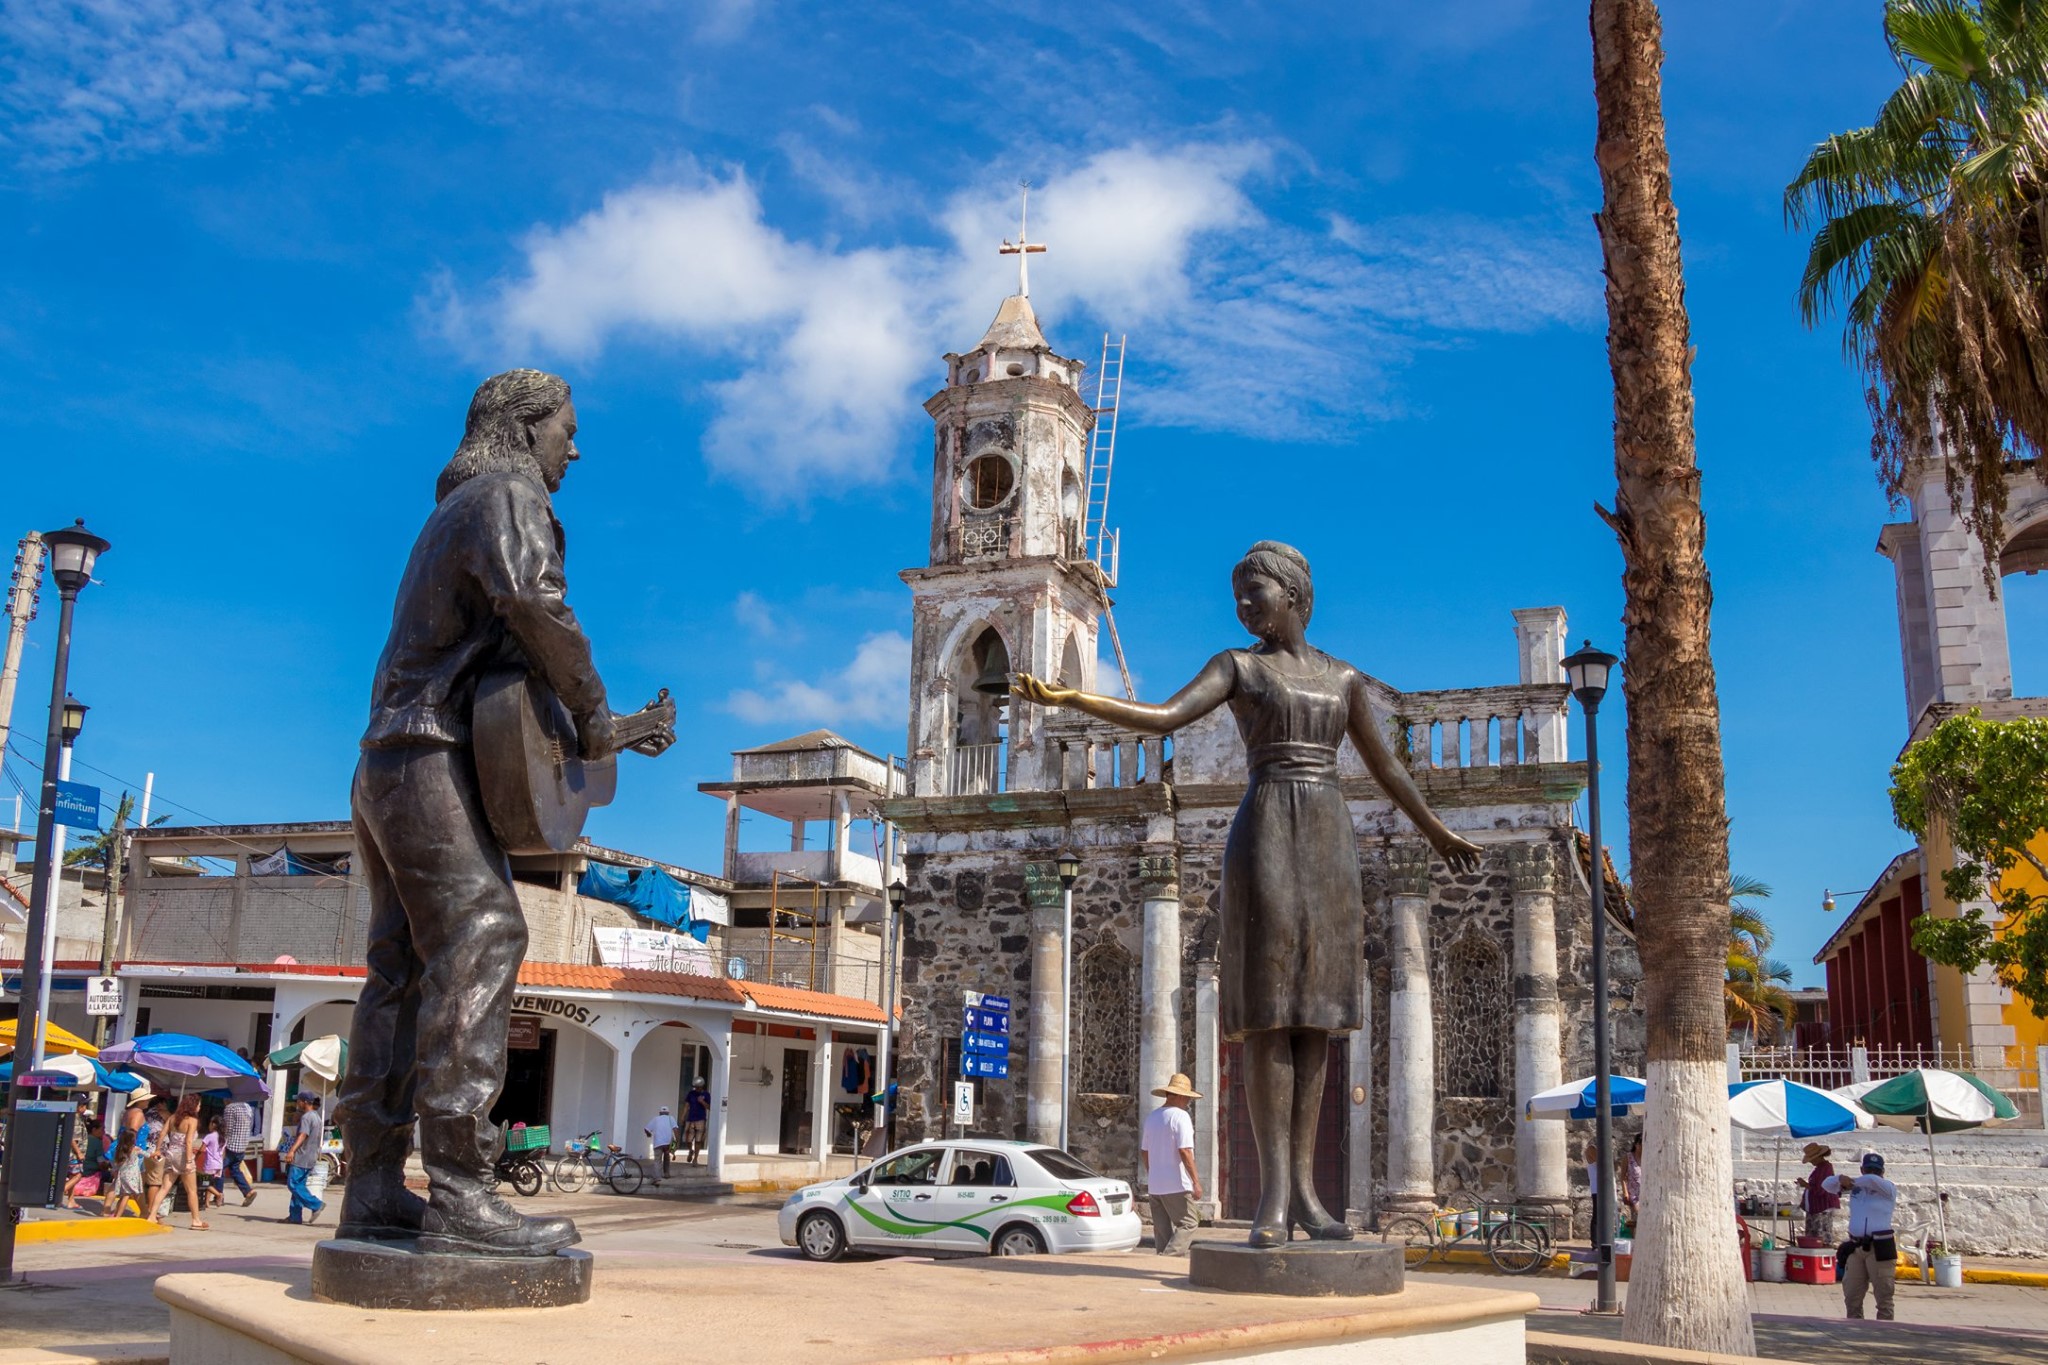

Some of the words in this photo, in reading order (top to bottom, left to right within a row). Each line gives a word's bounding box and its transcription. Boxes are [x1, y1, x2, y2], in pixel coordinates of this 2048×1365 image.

[55, 798, 96, 814] infinitum
[90, 995, 122, 1003] AUTOBUSES
[892, 1189, 911, 1198] SITIO
